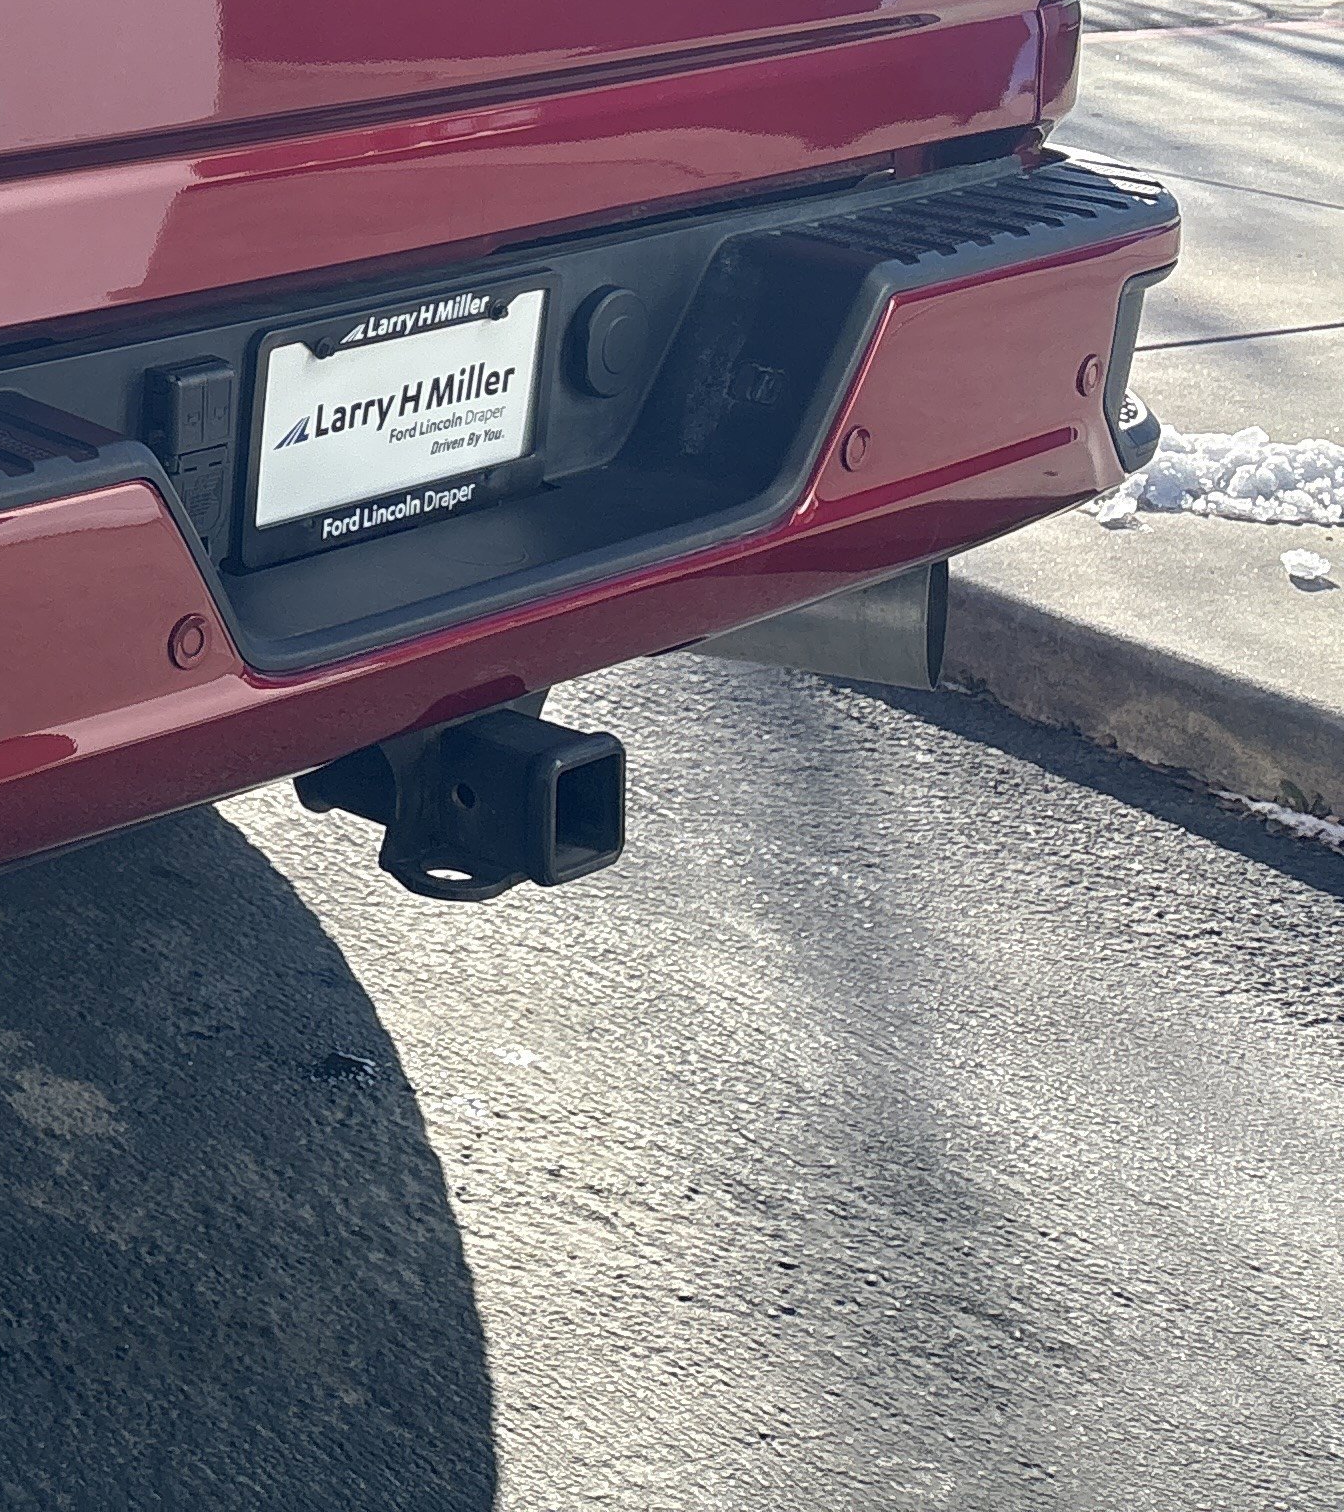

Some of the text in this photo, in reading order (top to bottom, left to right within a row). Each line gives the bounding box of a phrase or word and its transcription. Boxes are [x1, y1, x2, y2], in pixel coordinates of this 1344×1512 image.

[367, 293, 490, 338] Larry H Miller
[315, 362, 516, 438] Larry H Miller
[389, 406, 507, 443] Ford Lincoln Draper
[430, 437, 465, 455] Driven
[467, 432, 482, 447] By
[322, 483, 476, 540] Ford Lincoln Draper
